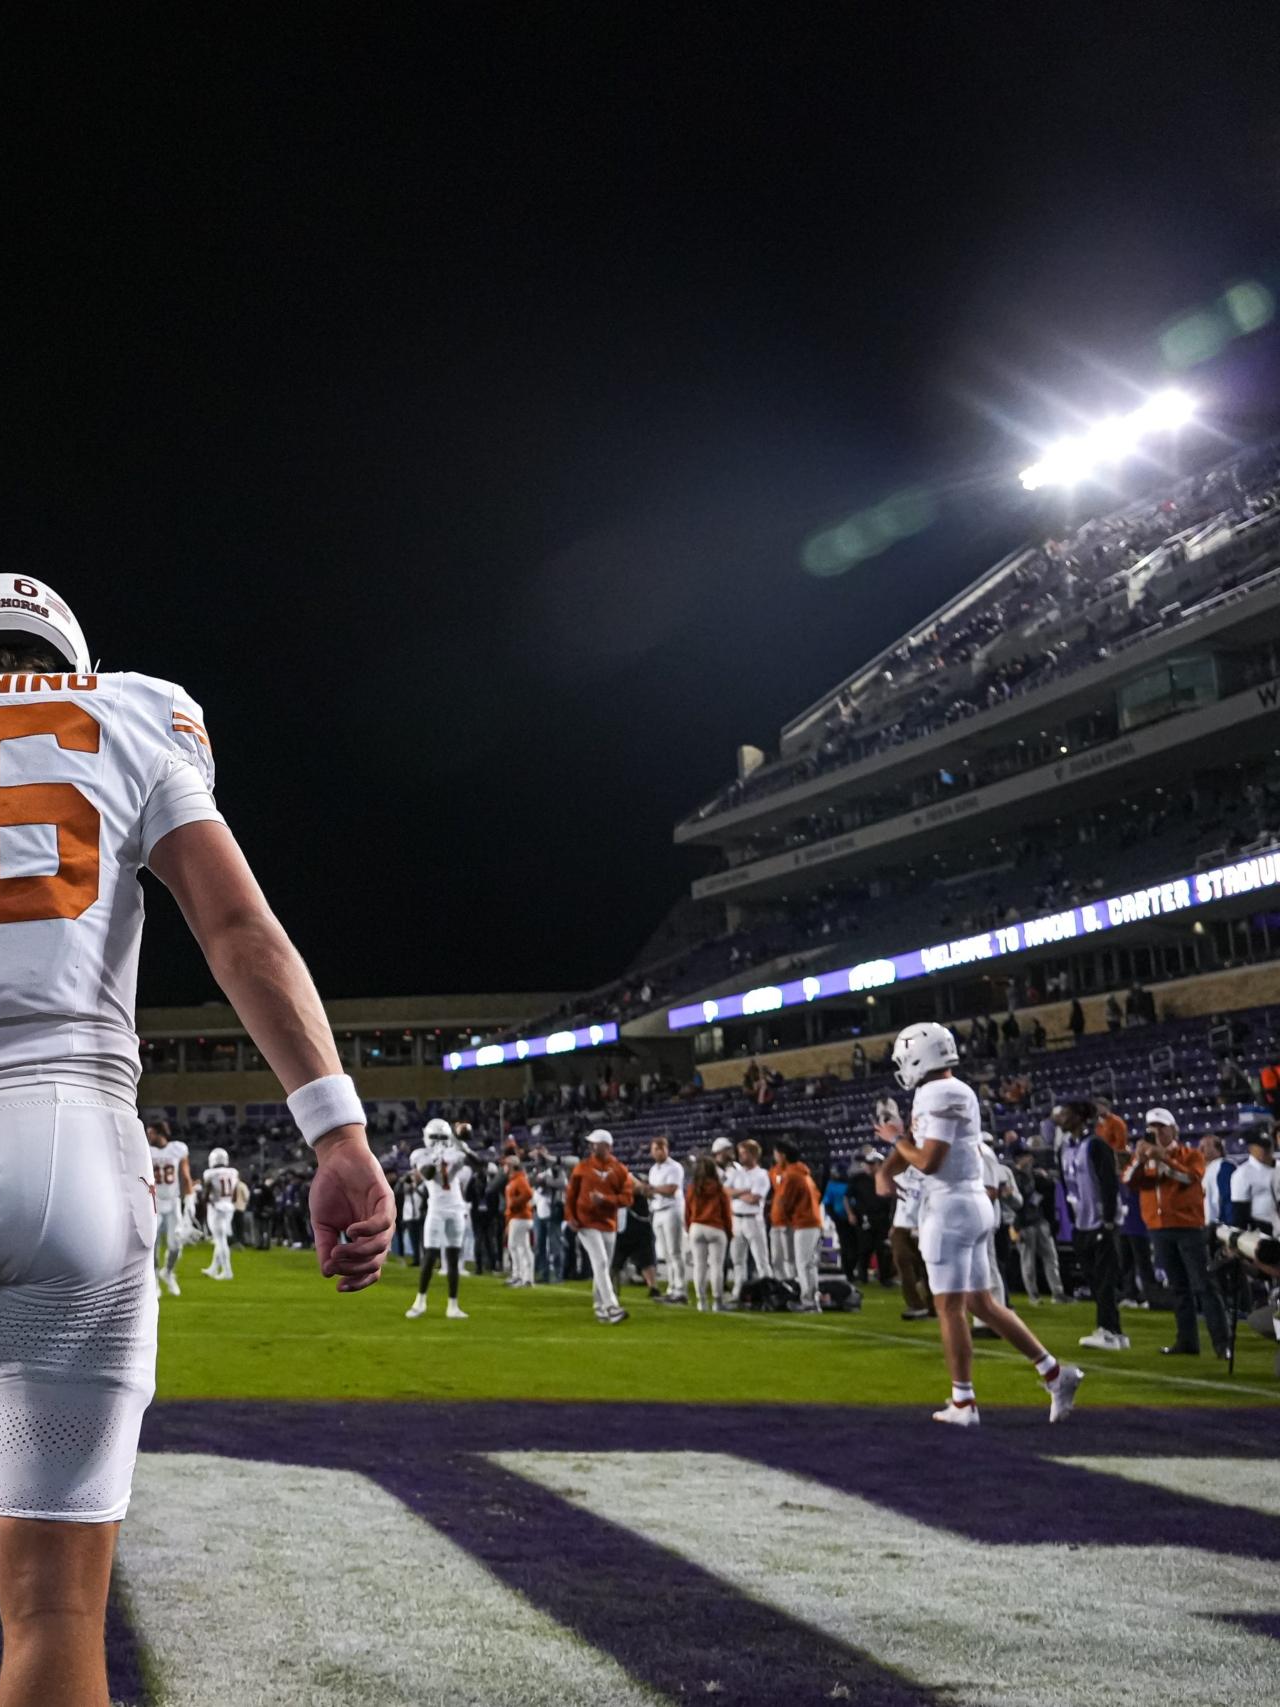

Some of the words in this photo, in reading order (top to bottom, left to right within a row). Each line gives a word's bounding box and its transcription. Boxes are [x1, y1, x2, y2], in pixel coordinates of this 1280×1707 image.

[996, 928, 1019, 953] TO
[1107, 880, 1190, 926] CARTER
[219, 1176, 233, 1197] 11
